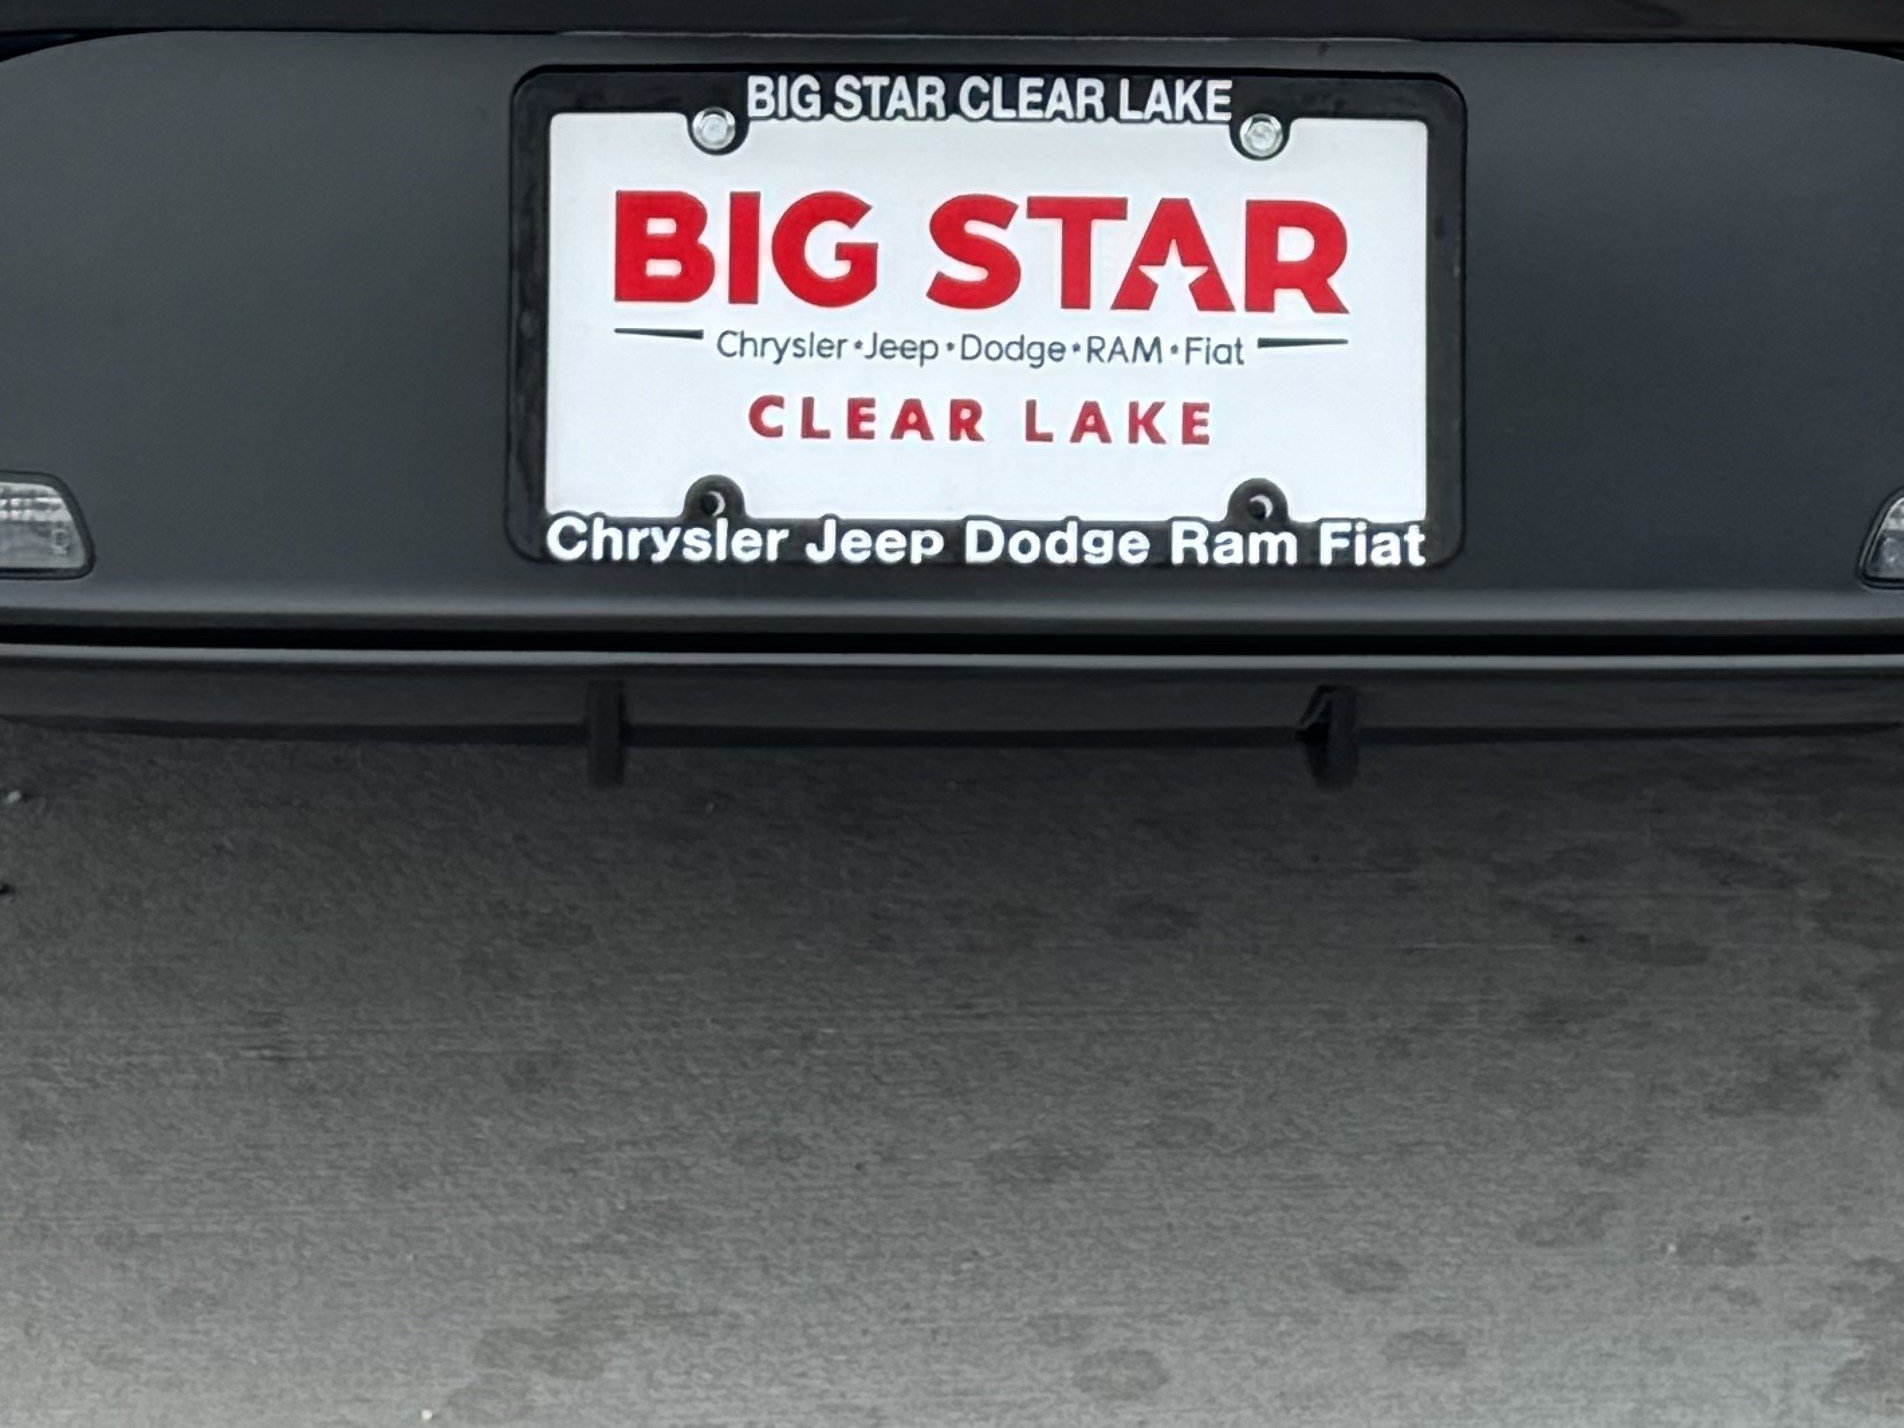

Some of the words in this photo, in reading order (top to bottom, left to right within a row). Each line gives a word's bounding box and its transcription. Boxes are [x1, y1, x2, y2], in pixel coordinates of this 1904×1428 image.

[746, 74, 822, 120] BIG
[832, 73, 947, 120] STAR
[958, 75, 1106, 122] CLEAR
[1118, 77, 1234, 123] LAKE
[613, 189, 879, 310] BIG
[927, 194, 1350, 314] STAR
[715, 328, 849, 366] Chrysler
[748, 394, 986, 442] CLEAR
[1024, 400, 1212, 446] LAKE
[545, 514, 790, 565] Chrysler
[804, 517, 946, 568] Jeep
[964, 518, 1152, 568] Dodge
[1170, 519, 1299, 568] Ram
[1318, 519, 1428, 569] Fiat
